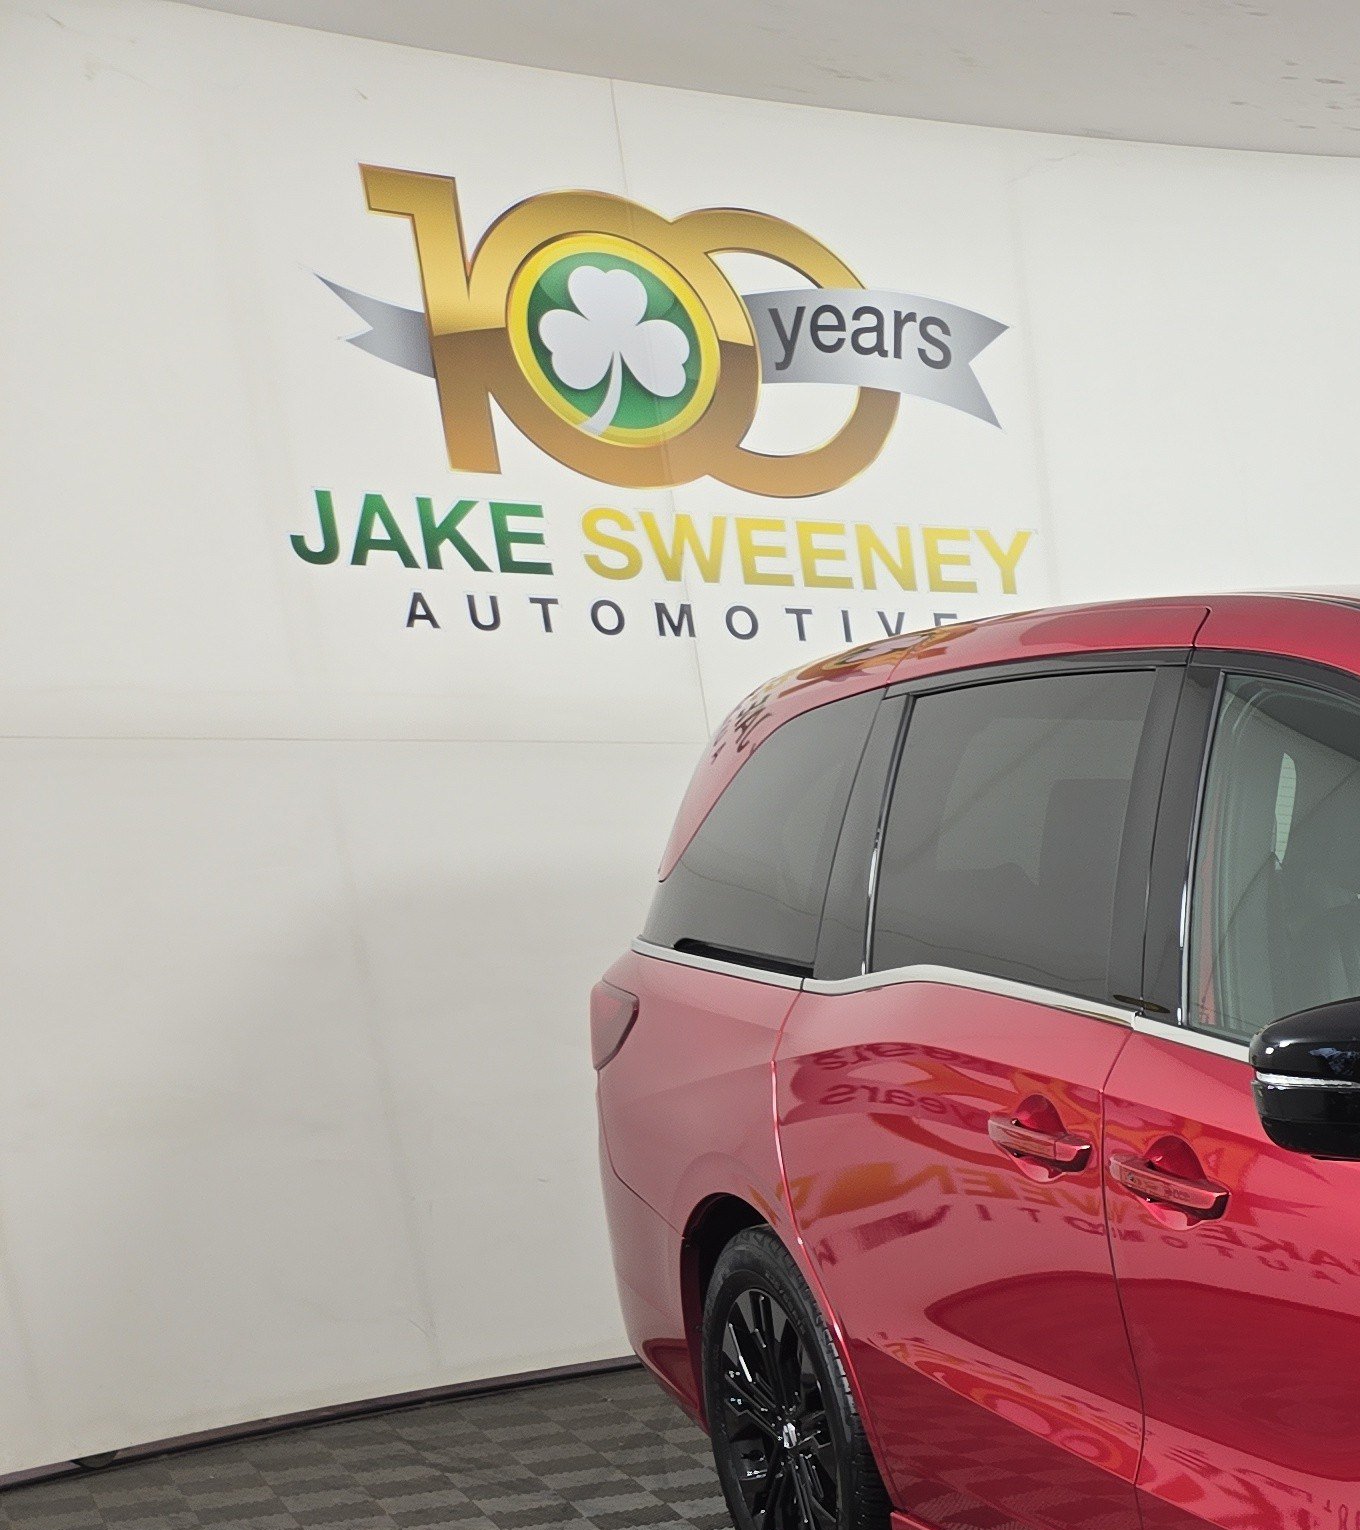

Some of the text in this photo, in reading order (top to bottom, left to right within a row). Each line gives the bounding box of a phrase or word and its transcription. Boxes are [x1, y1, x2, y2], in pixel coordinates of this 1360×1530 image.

[767, 304, 954, 371] years
[289, 488, 1033, 595] JAKE SWEENEY
